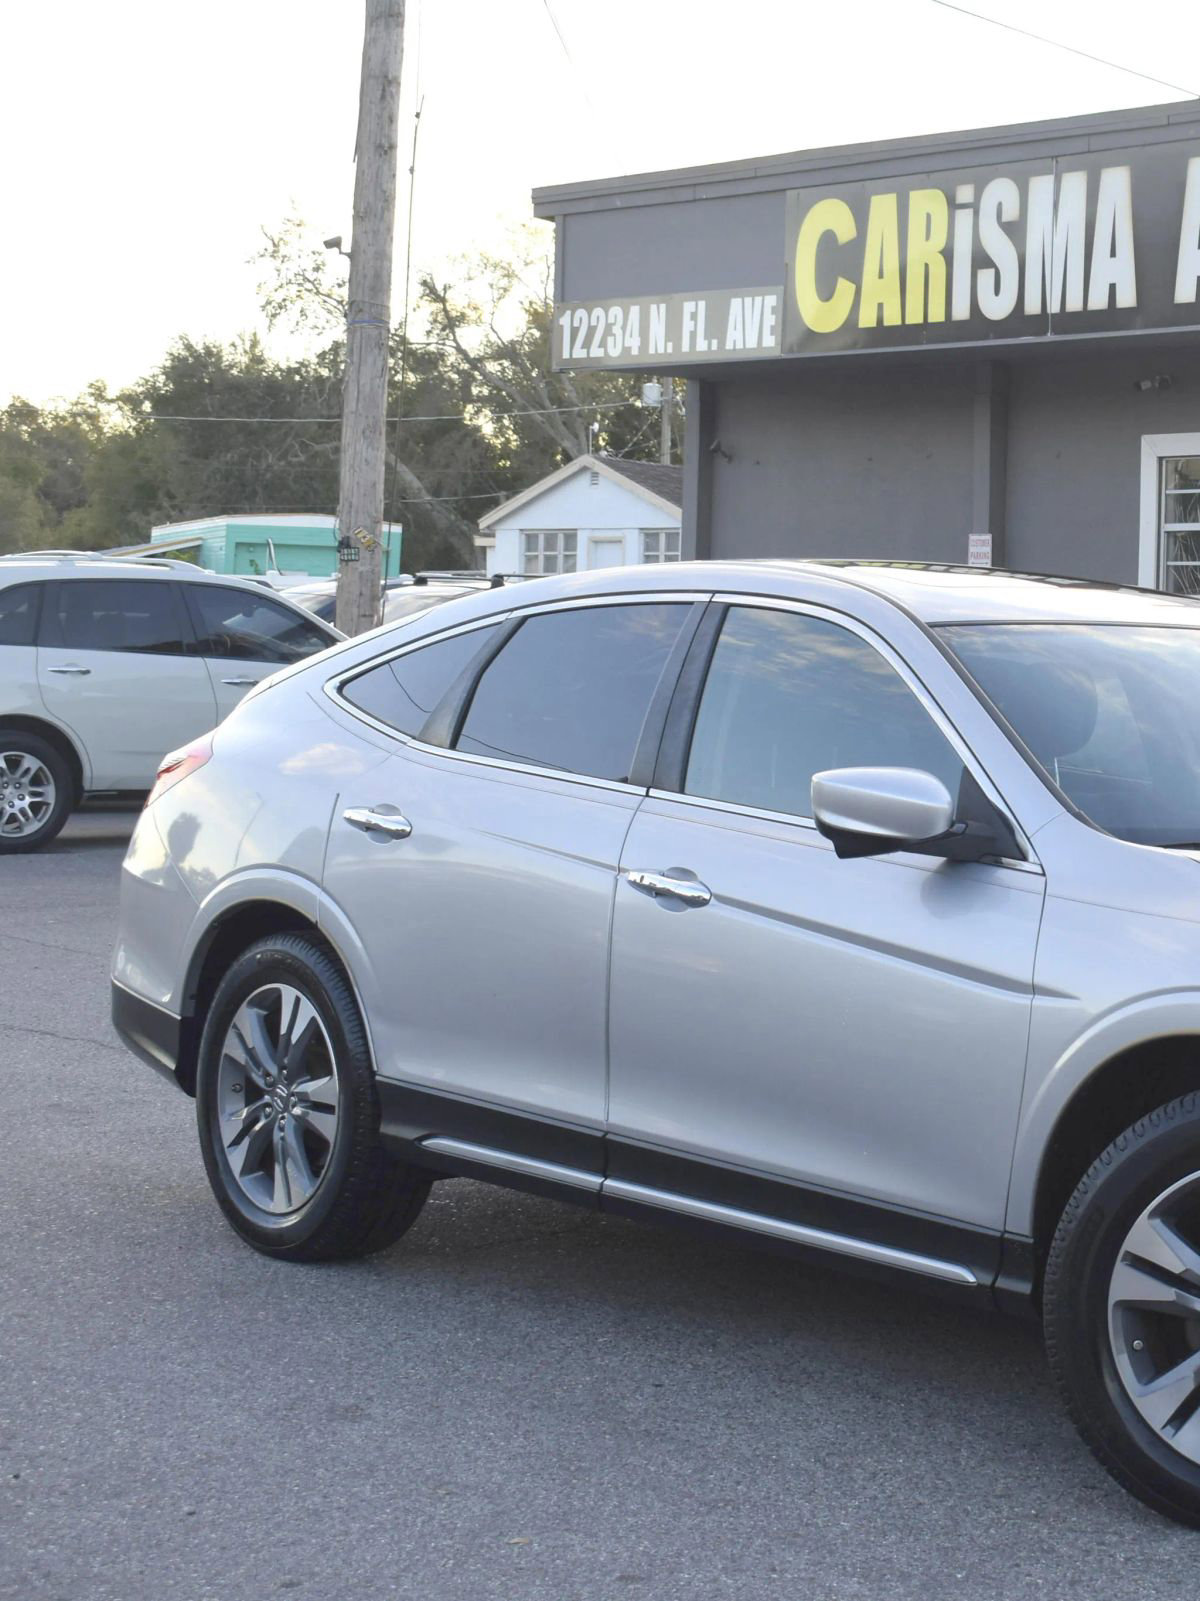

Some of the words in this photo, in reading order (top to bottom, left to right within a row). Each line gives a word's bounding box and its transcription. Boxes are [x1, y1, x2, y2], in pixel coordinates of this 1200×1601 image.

[559, 304, 641, 360] 12234
[648, 301, 673, 354] N.
[681, 299, 718, 352] FL.
[725, 294, 778, 350] AVE
